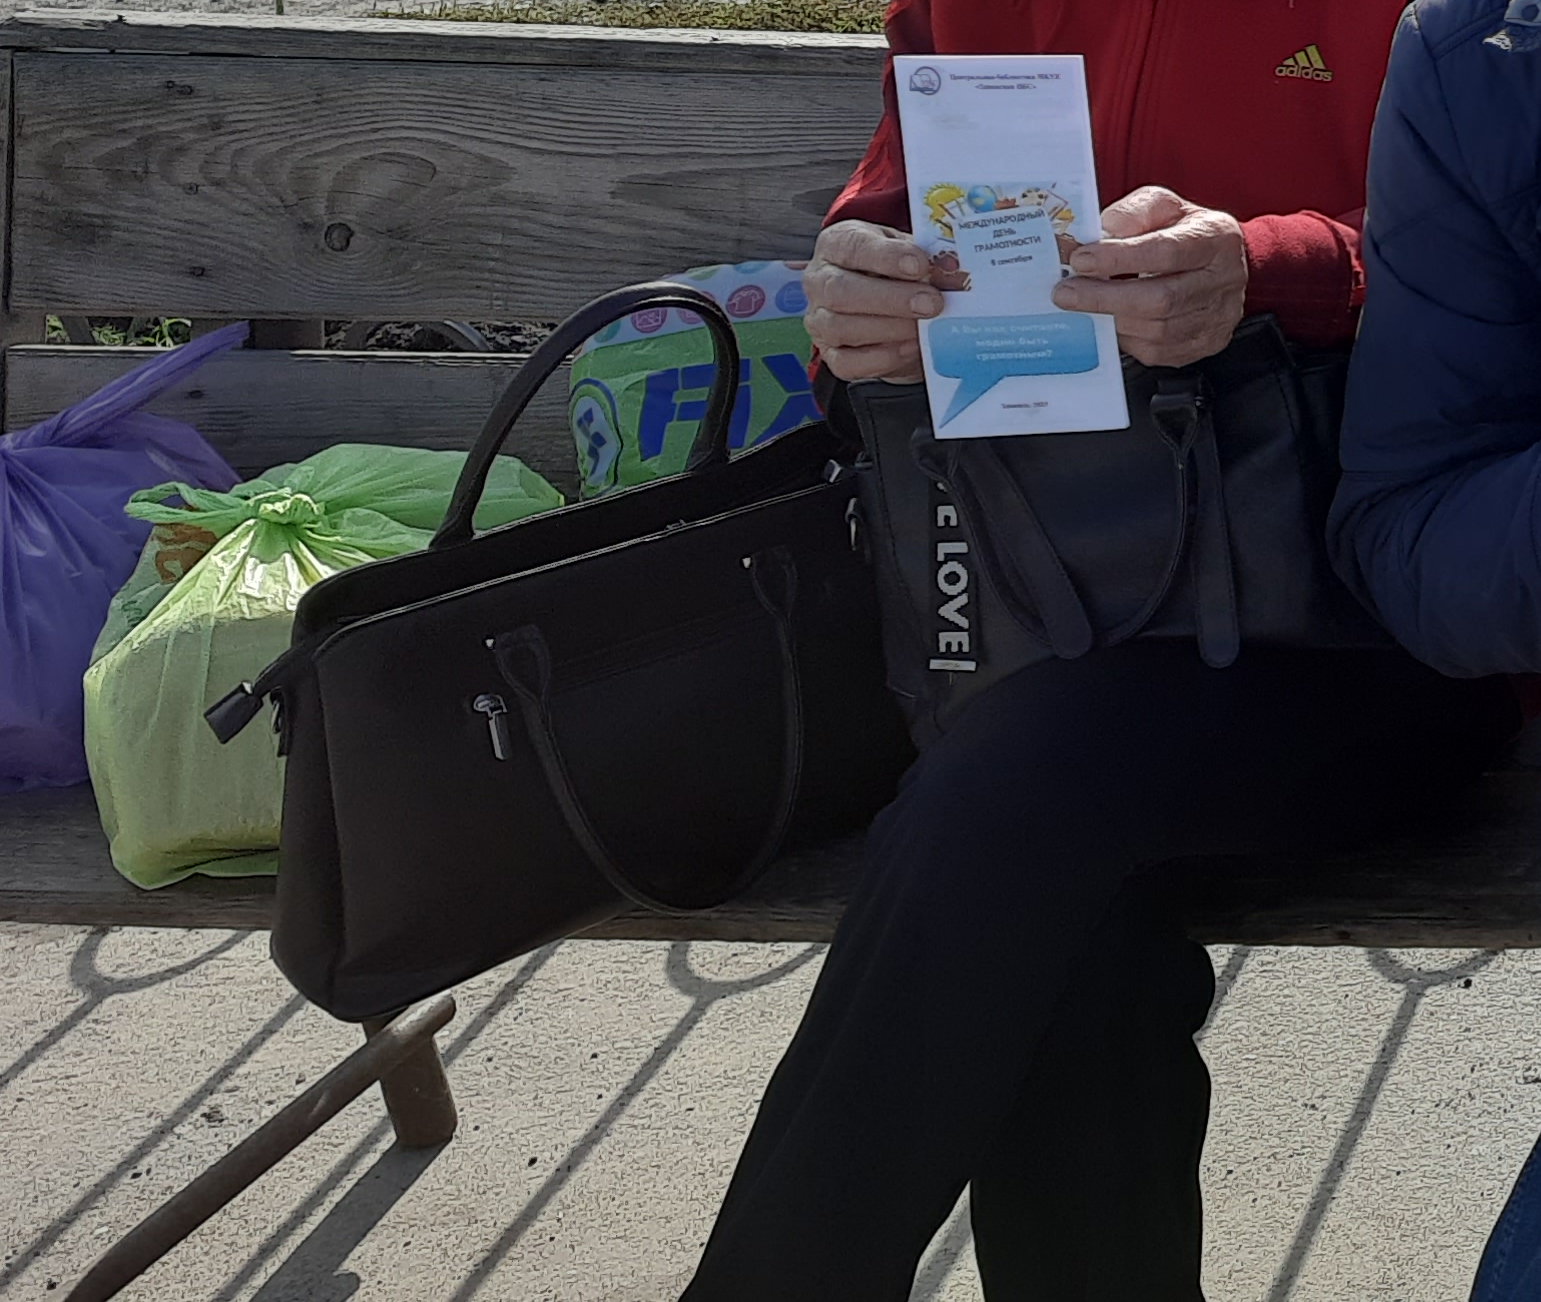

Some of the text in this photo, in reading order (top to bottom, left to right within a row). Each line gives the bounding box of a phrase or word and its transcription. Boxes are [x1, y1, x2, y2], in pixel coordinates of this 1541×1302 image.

[1275, 64, 1333, 82] adidas
[958, 209, 1046, 230] МЕЖДУНАРОДНЫЙ
[993, 227, 1017, 239] ДЕНЬ
[974, 235, 1041, 253] ГРАМОТНОСТИ
[937, 542, 970, 653] LOVE
